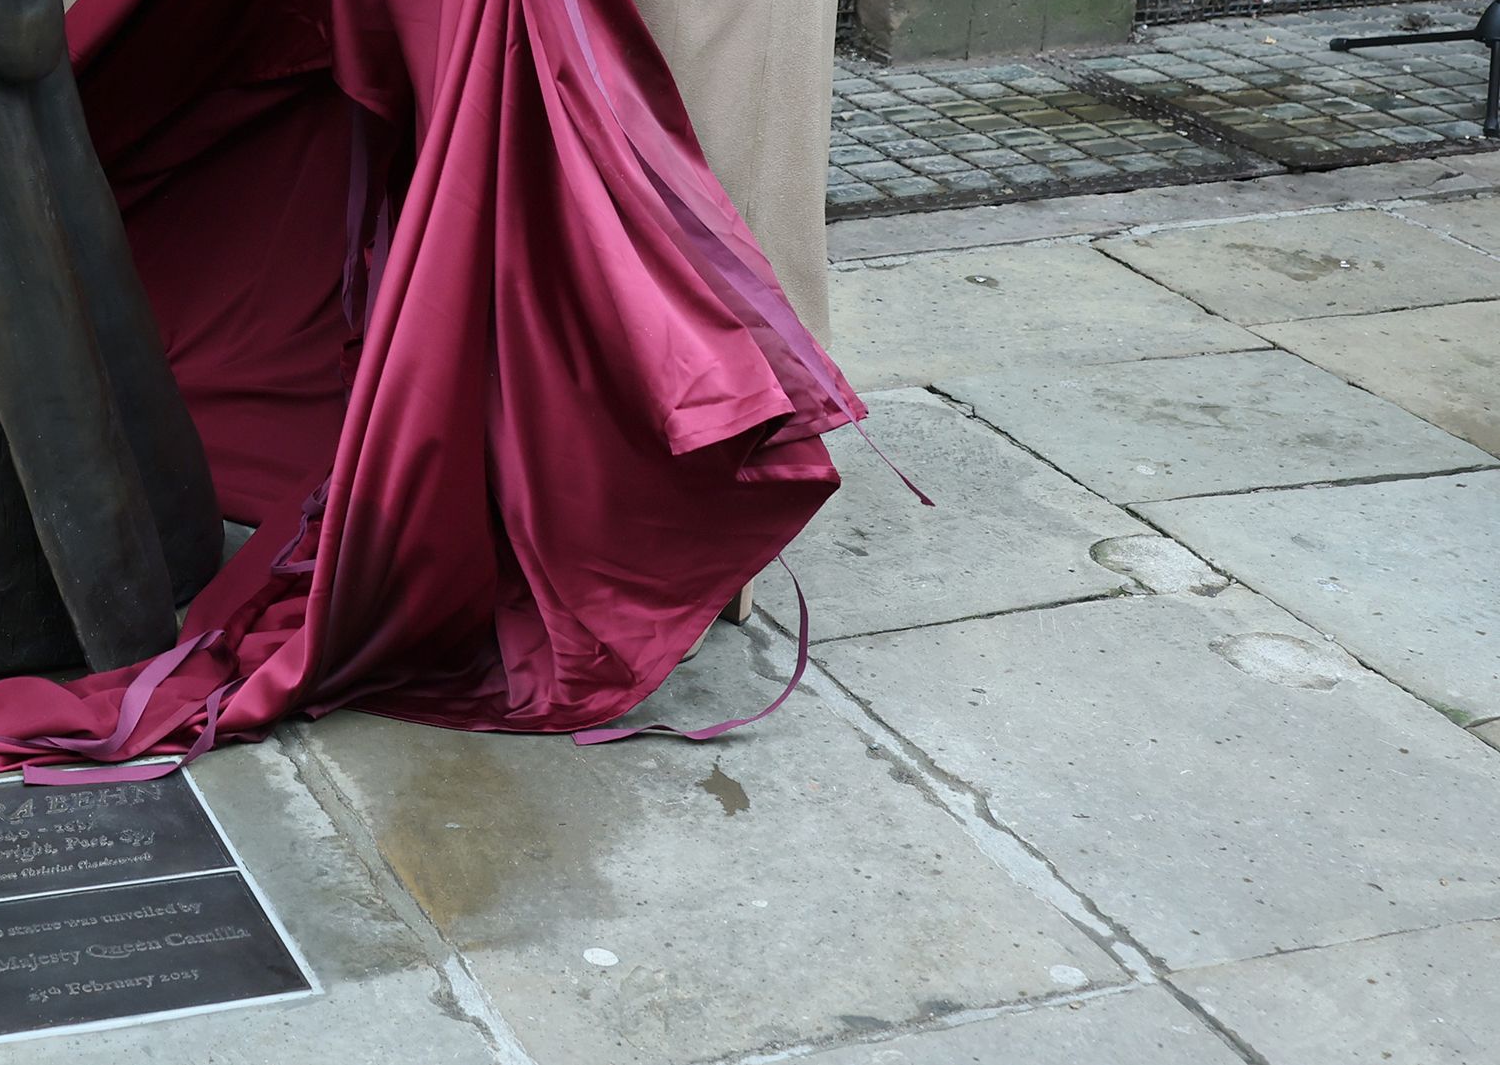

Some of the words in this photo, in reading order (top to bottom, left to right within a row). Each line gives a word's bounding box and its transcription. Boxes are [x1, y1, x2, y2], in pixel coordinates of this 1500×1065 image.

[44, 783, 163, 815] BEHN
[119, 828, 156, 847] Spy
[7, 920, 61, 937] statue
[64, 916, 98, 928] was
[102, 904, 177, 923] unveiled
[178, 901, 203, 915] by
[85, 937, 163, 960] Queen
[164, 924, 252, 947] Camilla
[65, 973, 155, 996] February
